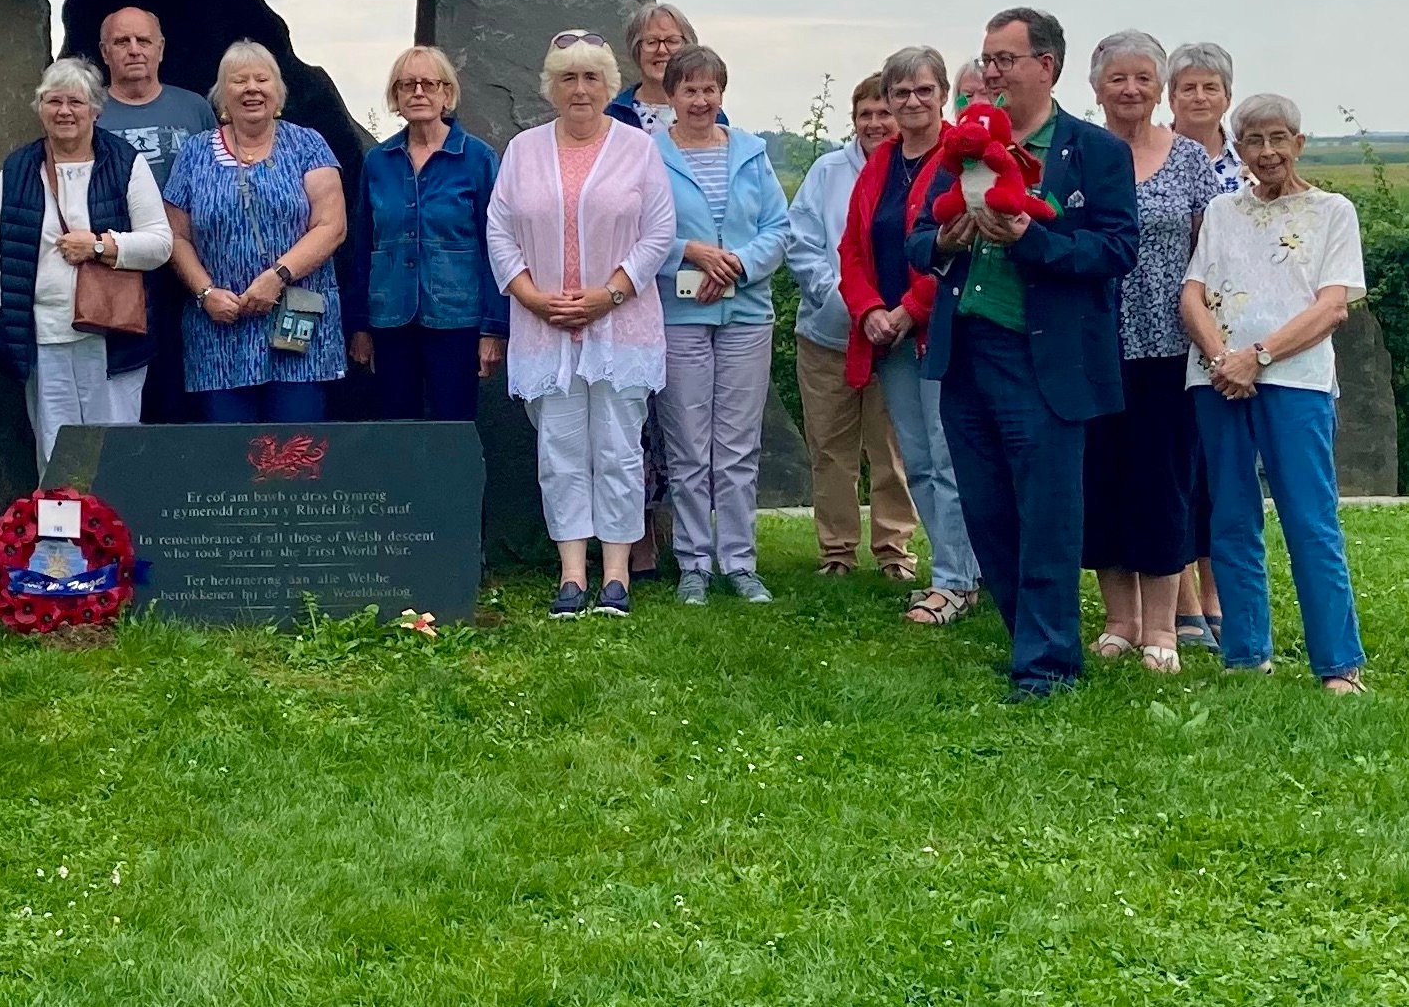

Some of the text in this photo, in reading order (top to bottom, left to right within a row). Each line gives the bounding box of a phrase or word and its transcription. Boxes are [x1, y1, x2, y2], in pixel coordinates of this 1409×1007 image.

[186, 492, 201, 503] Er
[206, 491, 226, 503] cof
[229, 493, 248, 503] am
[253, 491, 286, 503] bawb
[302, 491, 328, 502] dras
[333, 490, 387, 503] Gymreig
[161, 508, 168, 517] a
[173, 505, 233, 519] gymerodd
[238, 506, 258, 516] ran
[296, 504, 337, 516] Rhyfel
[139, 530, 435, 545] In remembrance of all those of Welsh descent
[163, 548, 190, 559] who
[195, 547, 222, 558] took
[229, 548, 255, 560] part
[280, 546, 300, 557] the
[307, 546, 336, 557] First
[342, 545, 378, 556] World
[385, 544, 412, 556] War.
[185, 574, 205, 586] Ter
